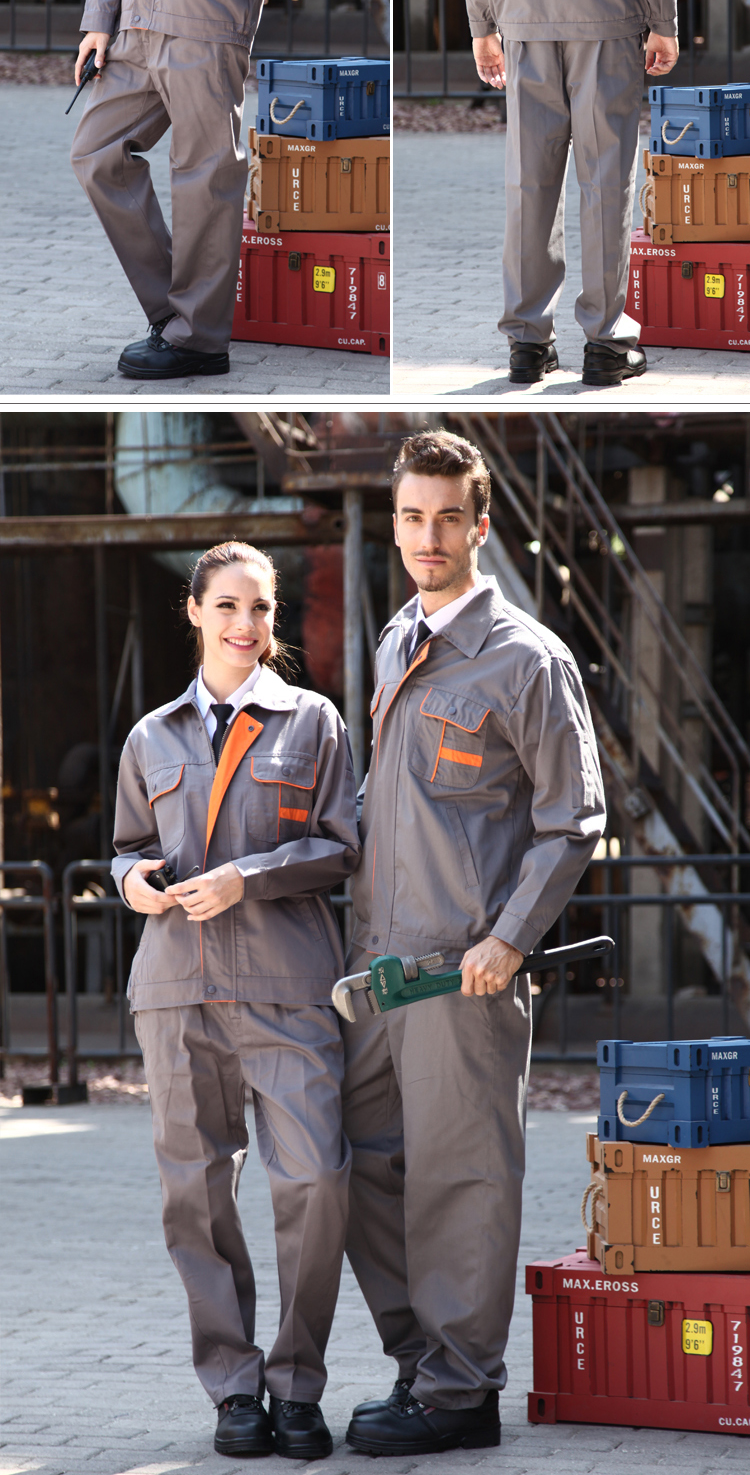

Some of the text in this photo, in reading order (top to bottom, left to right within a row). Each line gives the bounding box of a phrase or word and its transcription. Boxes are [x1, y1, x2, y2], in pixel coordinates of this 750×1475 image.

[339, 69, 359, 77] MAXGR
[724, 92, 743, 100] MAXGR
[287, 144, 316, 152] MAXGR
[678, 162, 705, 170] MAXGR
[292, 168, 300, 212] URCE
[683, 184, 691, 225] URCE
[315, 268, 331, 278] 2.9m
[706, 275, 721, 285] 2.9m
[347, 267, 357, 320] 719847
[633, 269, 641, 311] URCE
[736, 273, 745, 323] 719847
[337, 337, 366, 346] CU.CAP.
[711, 1051, 738, 1061] MAXGR
[711, 1087, 720, 1115] URCE
[642, 1154, 682, 1164] MAXGR
[650, 1186, 661, 1245] URCE
[562, 1278, 639, 1293] MAX.EROSS
[685, 1322, 706, 1335] 2.9m
[574, 1311, 585, 1371] URCE
[730, 1320, 744, 1392] 719847
[718, 1417, 750, 1427] CU.CA
